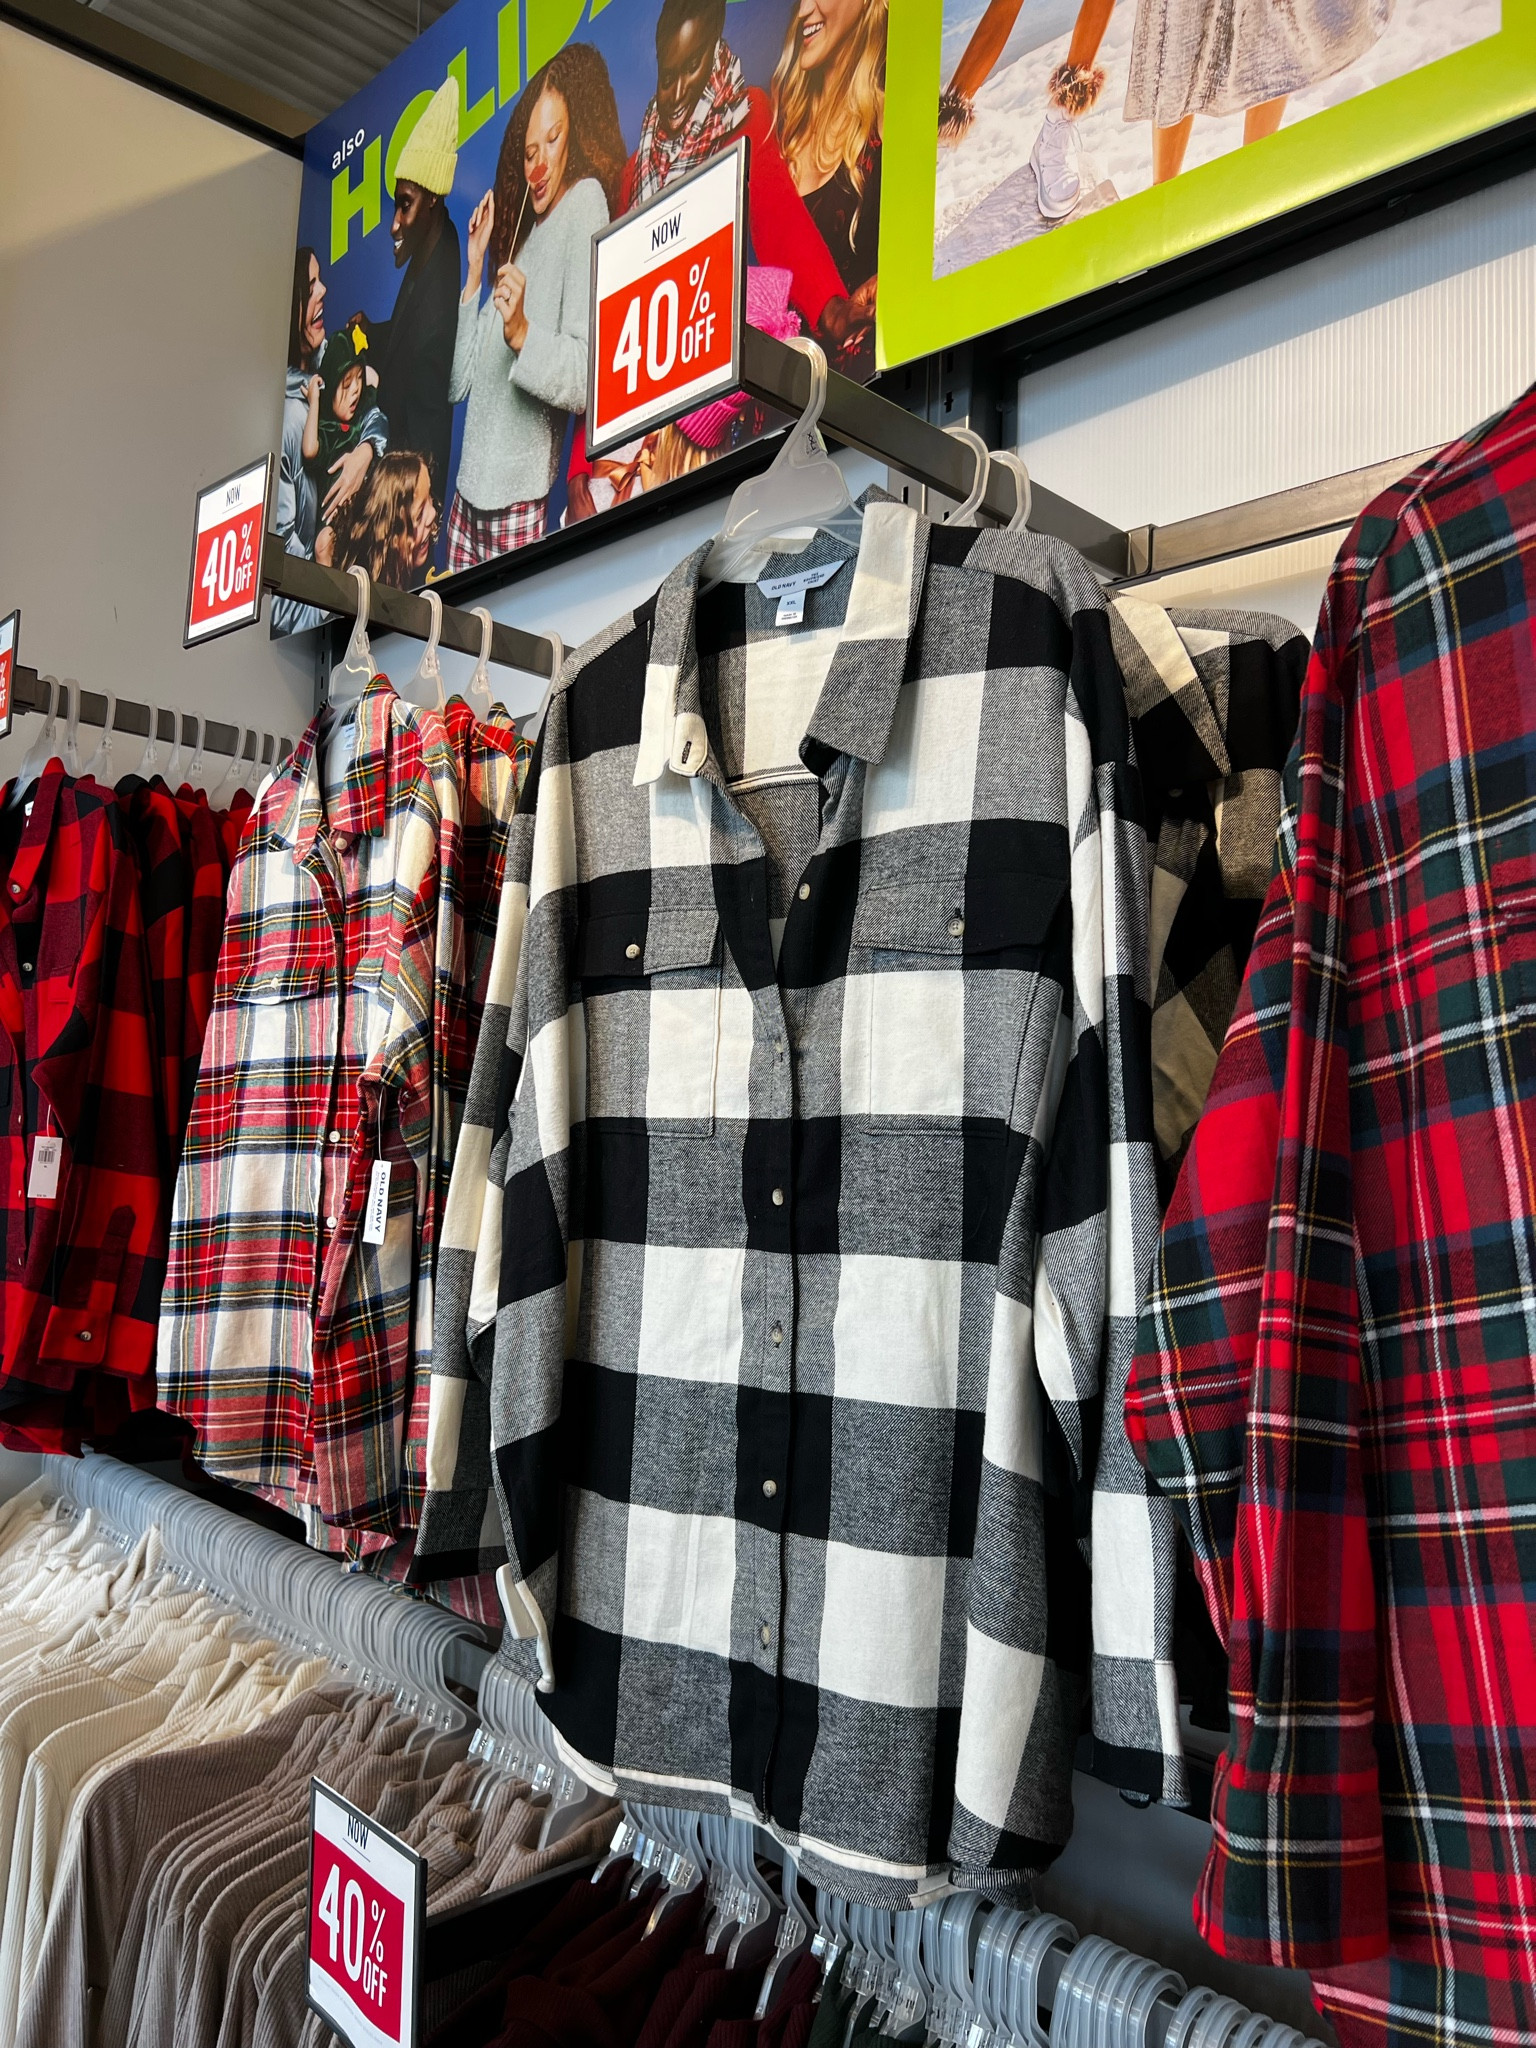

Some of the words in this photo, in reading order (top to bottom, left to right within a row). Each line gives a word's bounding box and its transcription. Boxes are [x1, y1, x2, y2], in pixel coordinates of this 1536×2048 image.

[330, 0, 613, 266] HLID
[331, 128, 365, 170] also
[651, 212, 682, 251] NOW
[681, 312, 716, 364] OFF
[226, 484, 242, 507] NOW
[234, 561, 254, 594] OFF
[771, 583, 782, 591] OLD
[375, 1199, 383, 1232] NAVY
[347, 1813, 370, 1850] NOW
[362, 1955, 388, 2008] OFF
